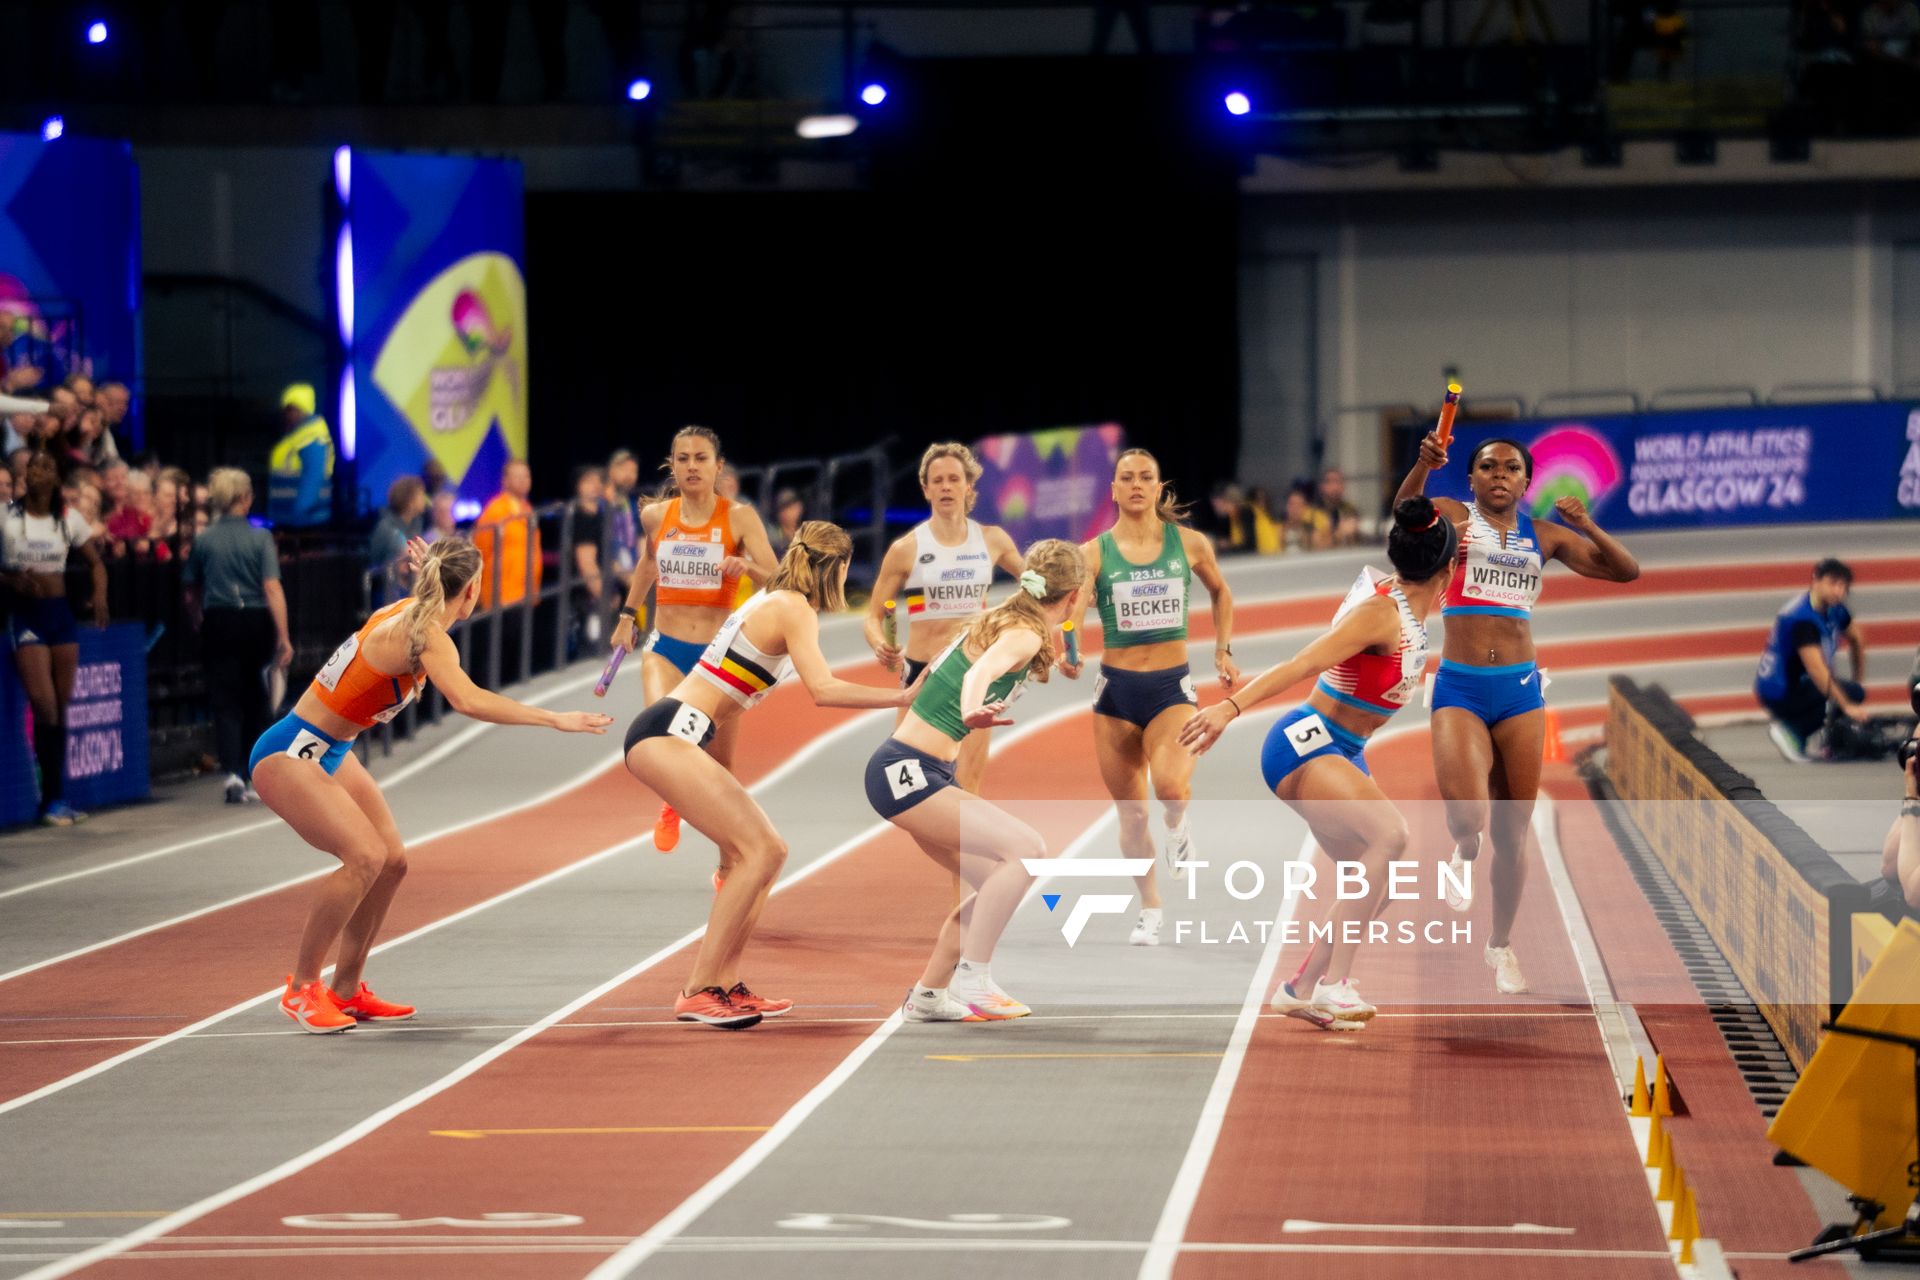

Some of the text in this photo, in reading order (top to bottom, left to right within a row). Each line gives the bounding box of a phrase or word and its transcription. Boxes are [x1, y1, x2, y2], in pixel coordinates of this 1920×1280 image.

[1634, 427, 1811, 460] WORLD ATHLETICS
[1687, 453, 1806, 477] CHAMPIONSHIPS
[1627, 476, 1805, 515] GLASGOW 24
[660, 559, 719, 577] SAALBERG
[1129, 569, 1165, 581] 123.ie
[1473, 566, 1538, 591] WRIGHT
[671, 576, 707, 586] GLASGOW
[1121, 599, 1180, 617] BECKER
[1135, 618, 1174, 628] GLASGOW
[681, 712, 699, 735] 3
[1295, 724, 1322, 745] 5
[297, 741, 319, 760] 6
[898, 764, 914, 787] 4
